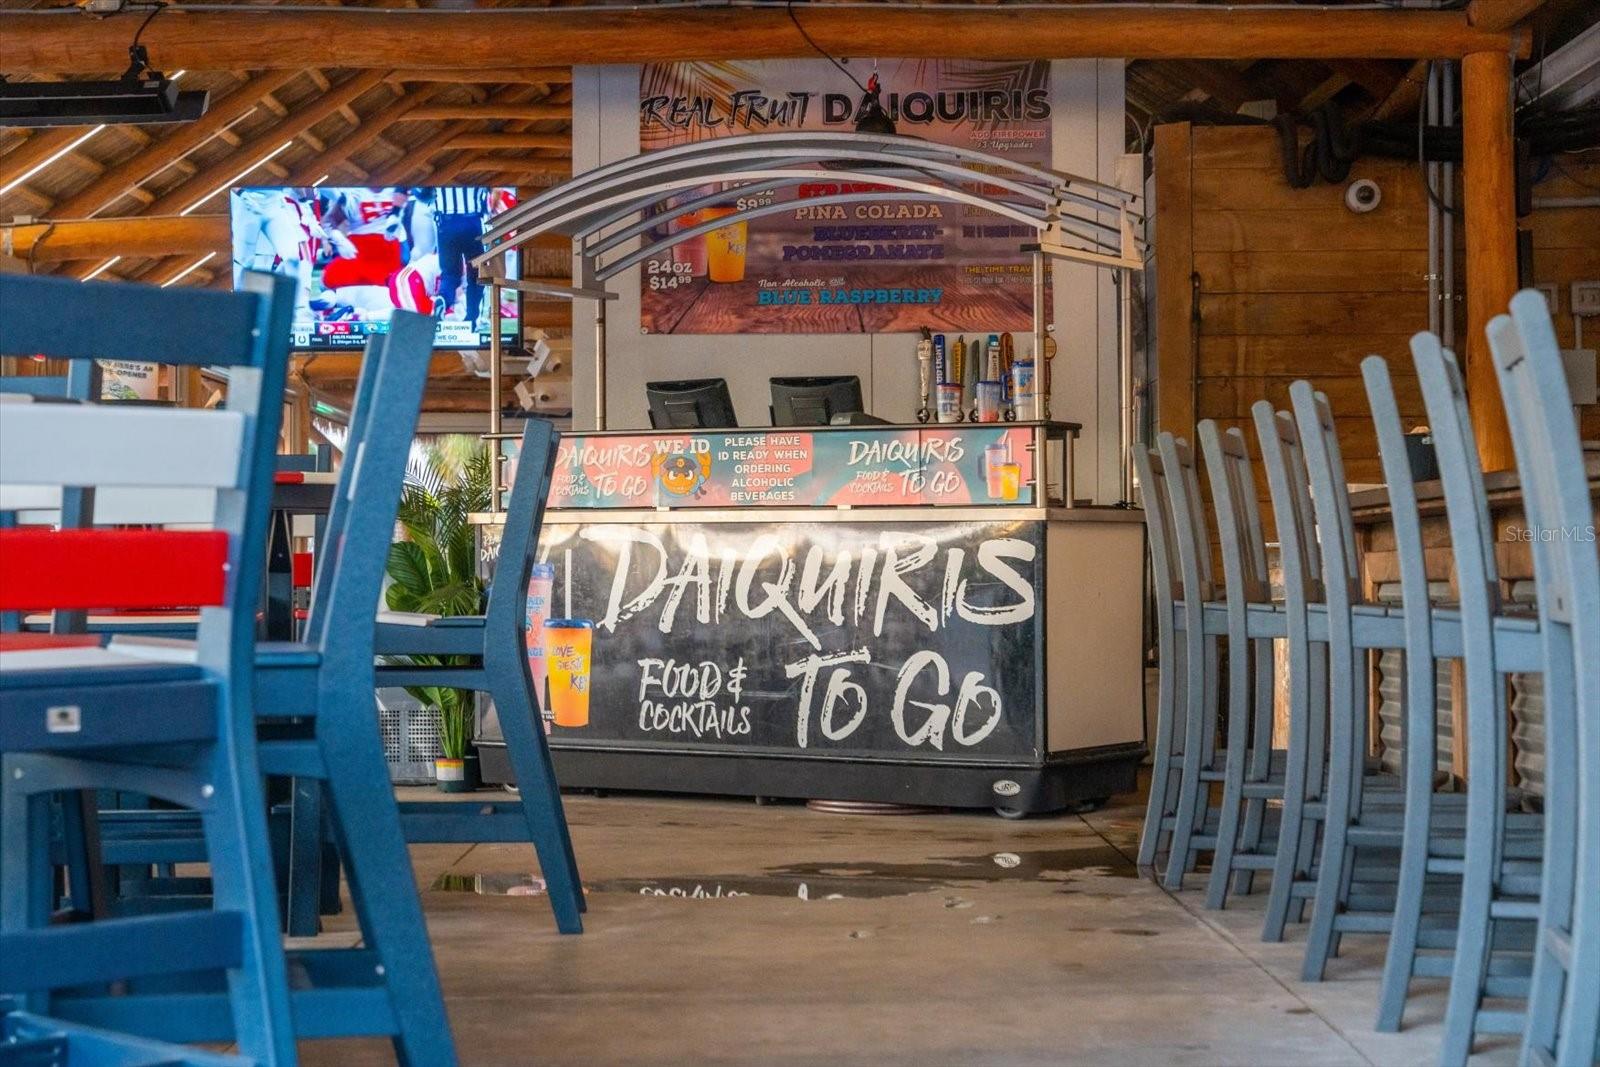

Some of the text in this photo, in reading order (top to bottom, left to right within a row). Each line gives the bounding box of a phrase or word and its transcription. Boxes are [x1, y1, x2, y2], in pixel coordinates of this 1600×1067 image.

[855, 205, 943, 220] COLADA
[782, 244, 945, 261] POMEGRANATE
[757, 288, 944, 305] BLUE RASPBERRY
[652, 438, 711, 455] WE ID
[724, 436, 801, 447] PLEASE HAVE
[718, 449, 808, 461] ID READY WHEN
[847, 437, 965, 468] DAIQUIRIS
[734, 463, 791, 474] ORDERING
[731, 477, 794, 487] ALCOHOLIC
[730, 490, 795, 501] BEVERAGES
[579, 524, 1035, 650] DAIQUIRIS
[637, 657, 748, 704] FOOD &
[639, 699, 751, 739] COCKTAILS
